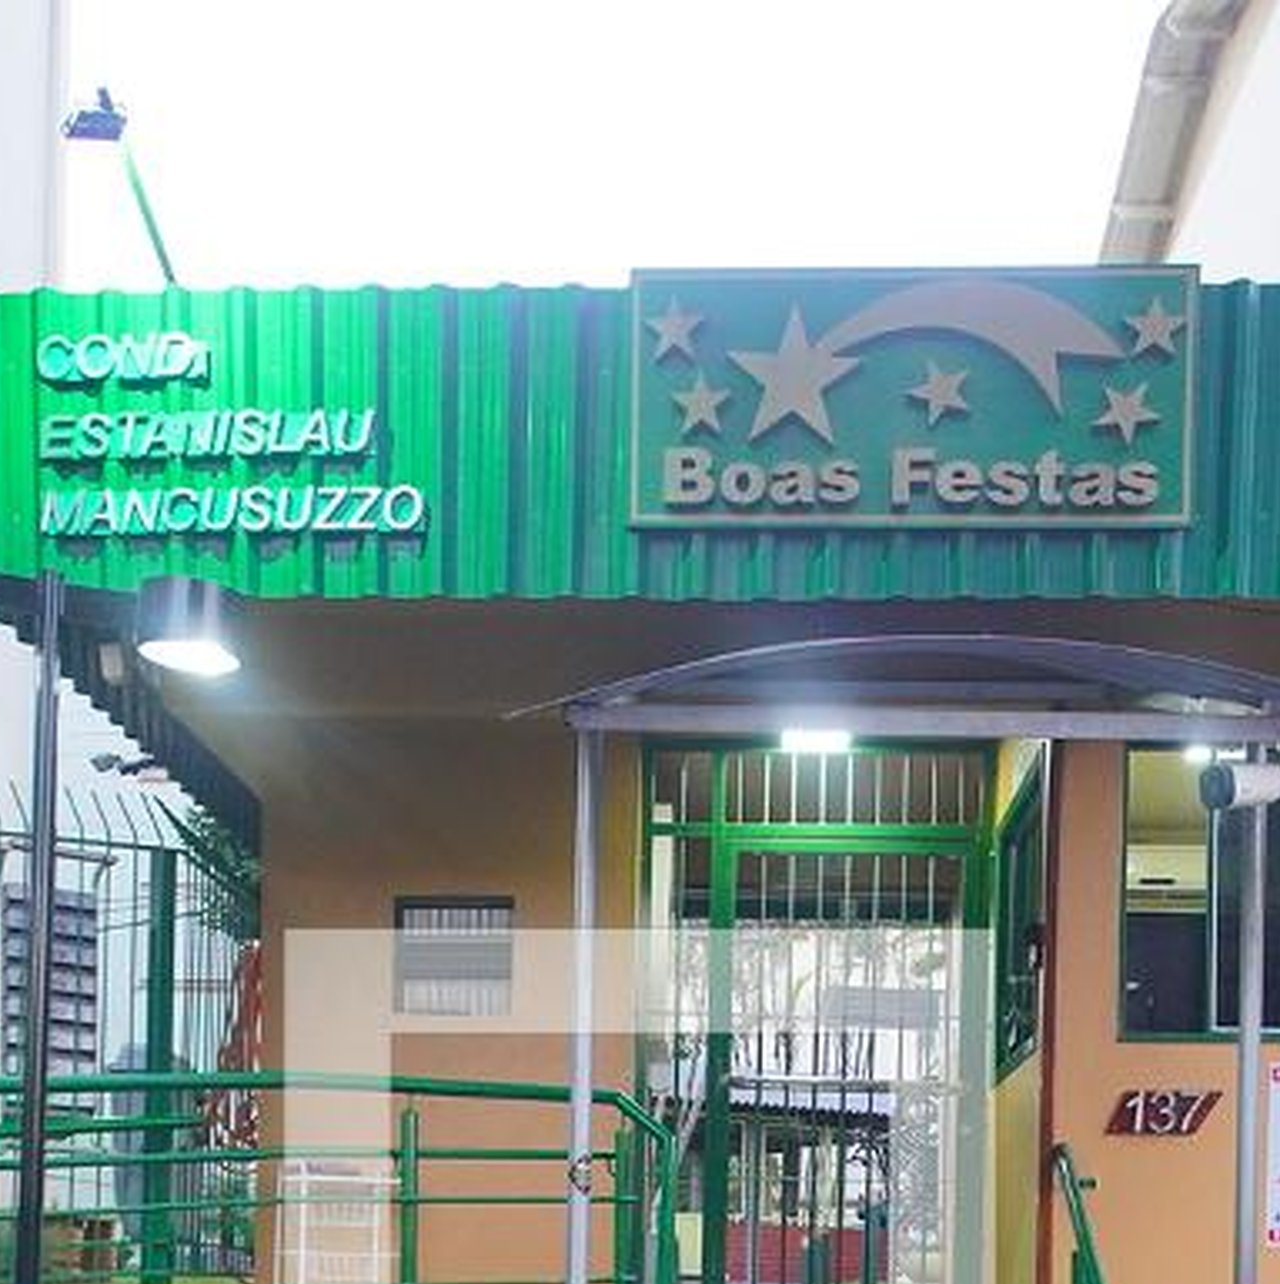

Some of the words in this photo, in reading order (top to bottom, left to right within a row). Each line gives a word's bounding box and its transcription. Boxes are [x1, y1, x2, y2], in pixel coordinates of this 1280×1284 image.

[39, 408, 375, 459] ESTANISLAU
[664, 446, 861, 506] Boas
[890, 446, 1161, 508] Festas
[39, 484, 426, 535] MANCUSUZZO
[1125, 1088, 1206, 1133] 137
